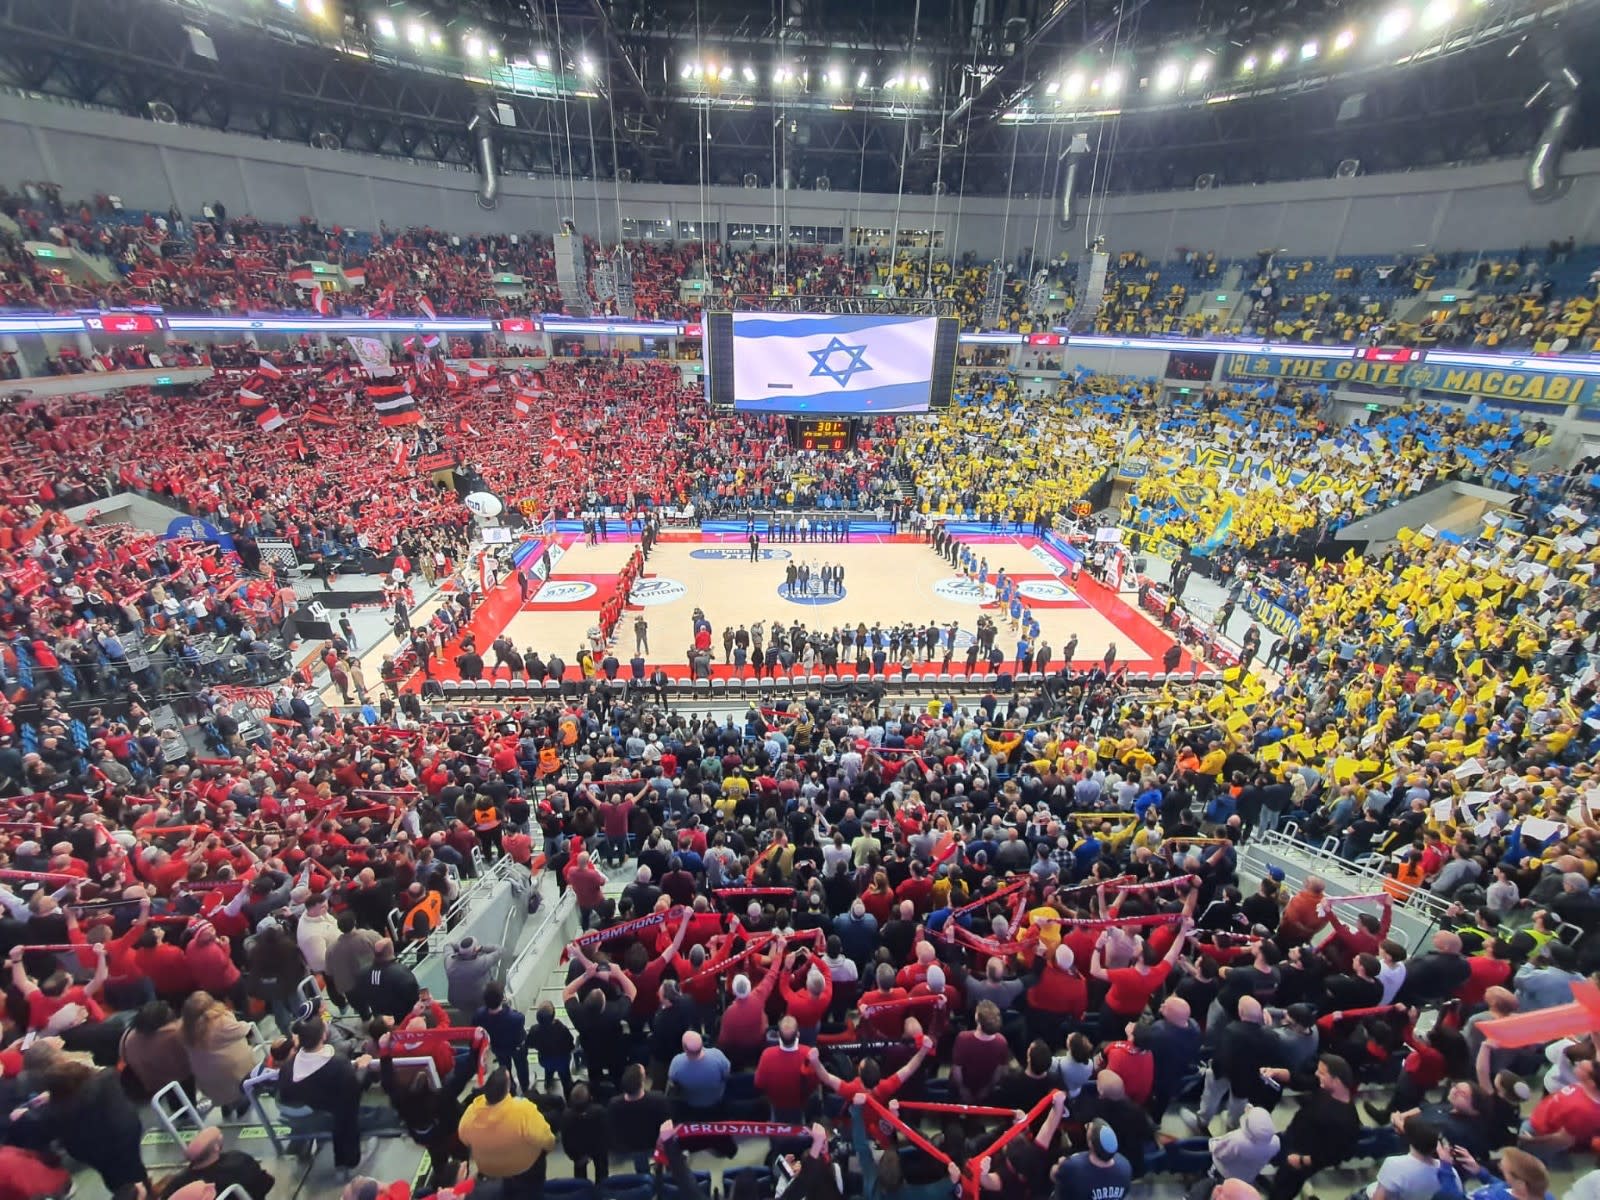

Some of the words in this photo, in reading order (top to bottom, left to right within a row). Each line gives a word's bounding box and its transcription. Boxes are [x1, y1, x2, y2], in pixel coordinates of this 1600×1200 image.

[1280, 358, 1329, 378] THE
[1334, 361, 1405, 384] GATE
[1443, 370, 1586, 402] MACCABI
[806, 439, 812, 449] 0
[834, 439, 841, 449] 0
[1193, 445, 1292, 486] YELLOW
[628, 586, 685, 599] YUNDAI
[581, 913, 665, 946] CHAMPIONS
[683, 1123, 792, 1135] JERUSALEM
[1091, 1185, 1125, 1200] JORDAN
